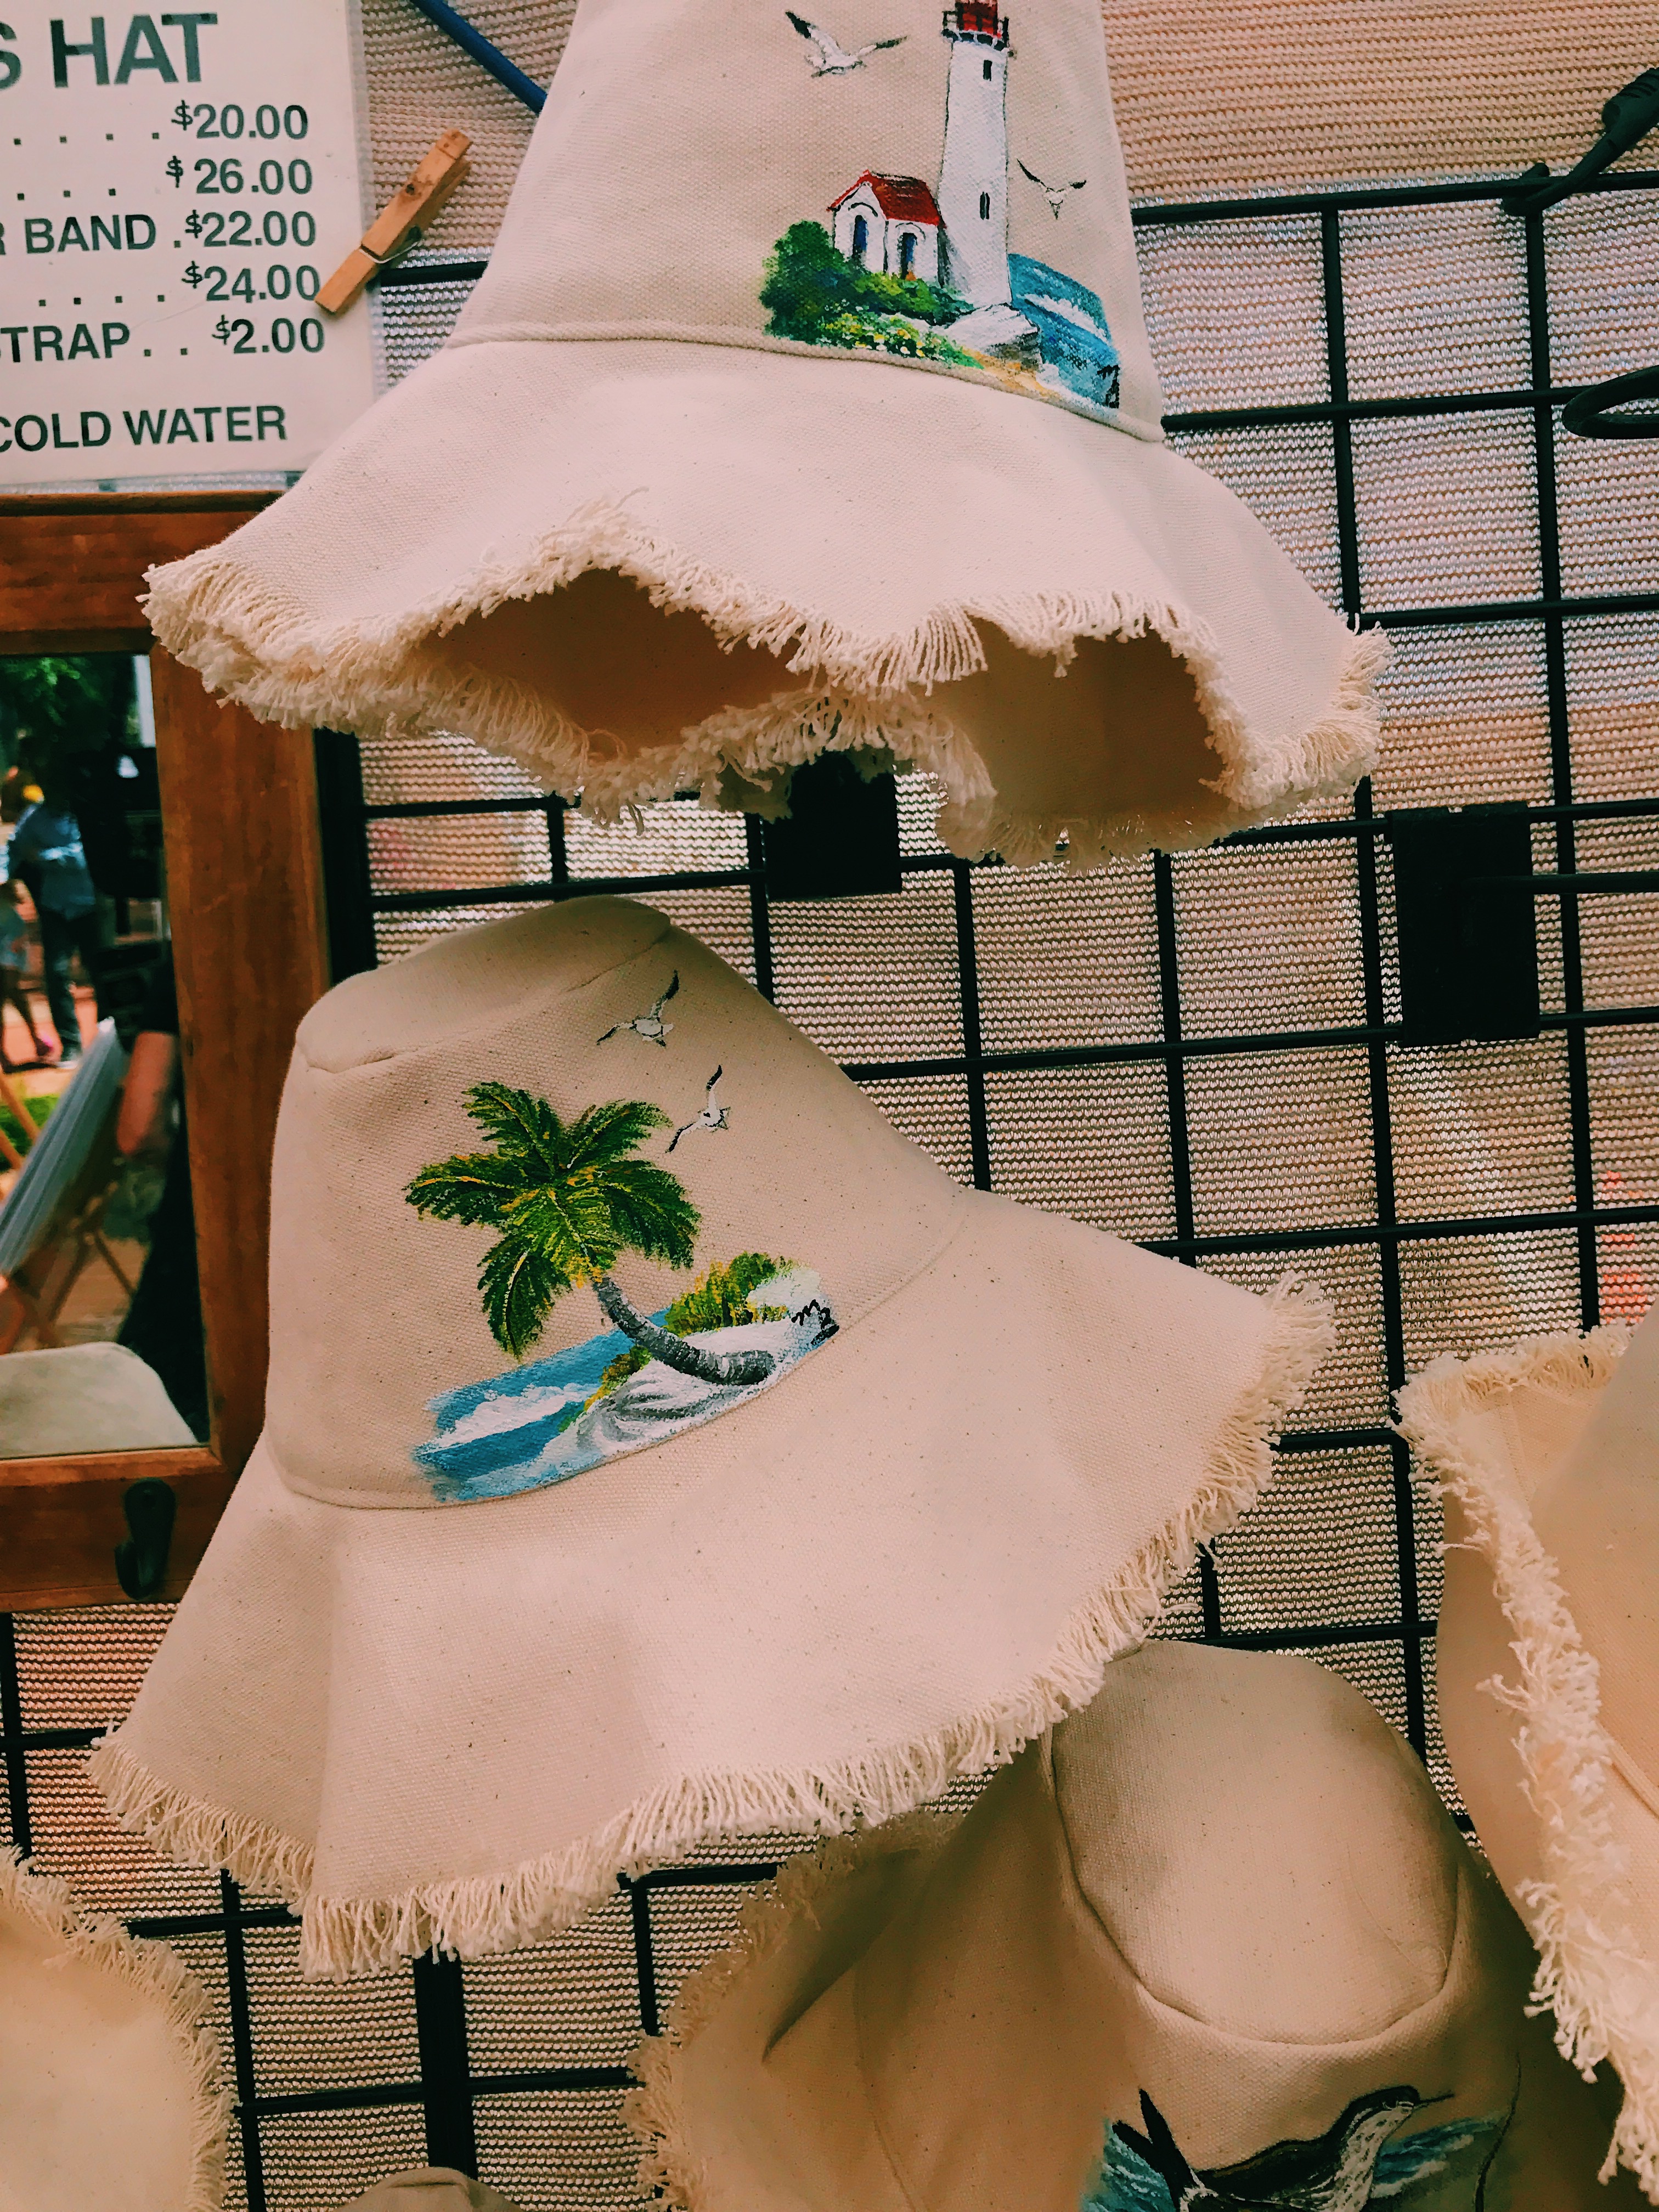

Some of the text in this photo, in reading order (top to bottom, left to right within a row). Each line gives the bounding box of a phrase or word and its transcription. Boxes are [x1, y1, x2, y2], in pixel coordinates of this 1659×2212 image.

[49, 13, 218, 88] HAT
[171, 100, 308, 139] $20.00
[24, 214, 156, 253] BAND
[184, 209, 316, 247] $22.00
[182, 261, 320, 303] $24.00
[0, 314, 325, 363] TRAP $2.00
[122, 405, 287, 445] WATER
